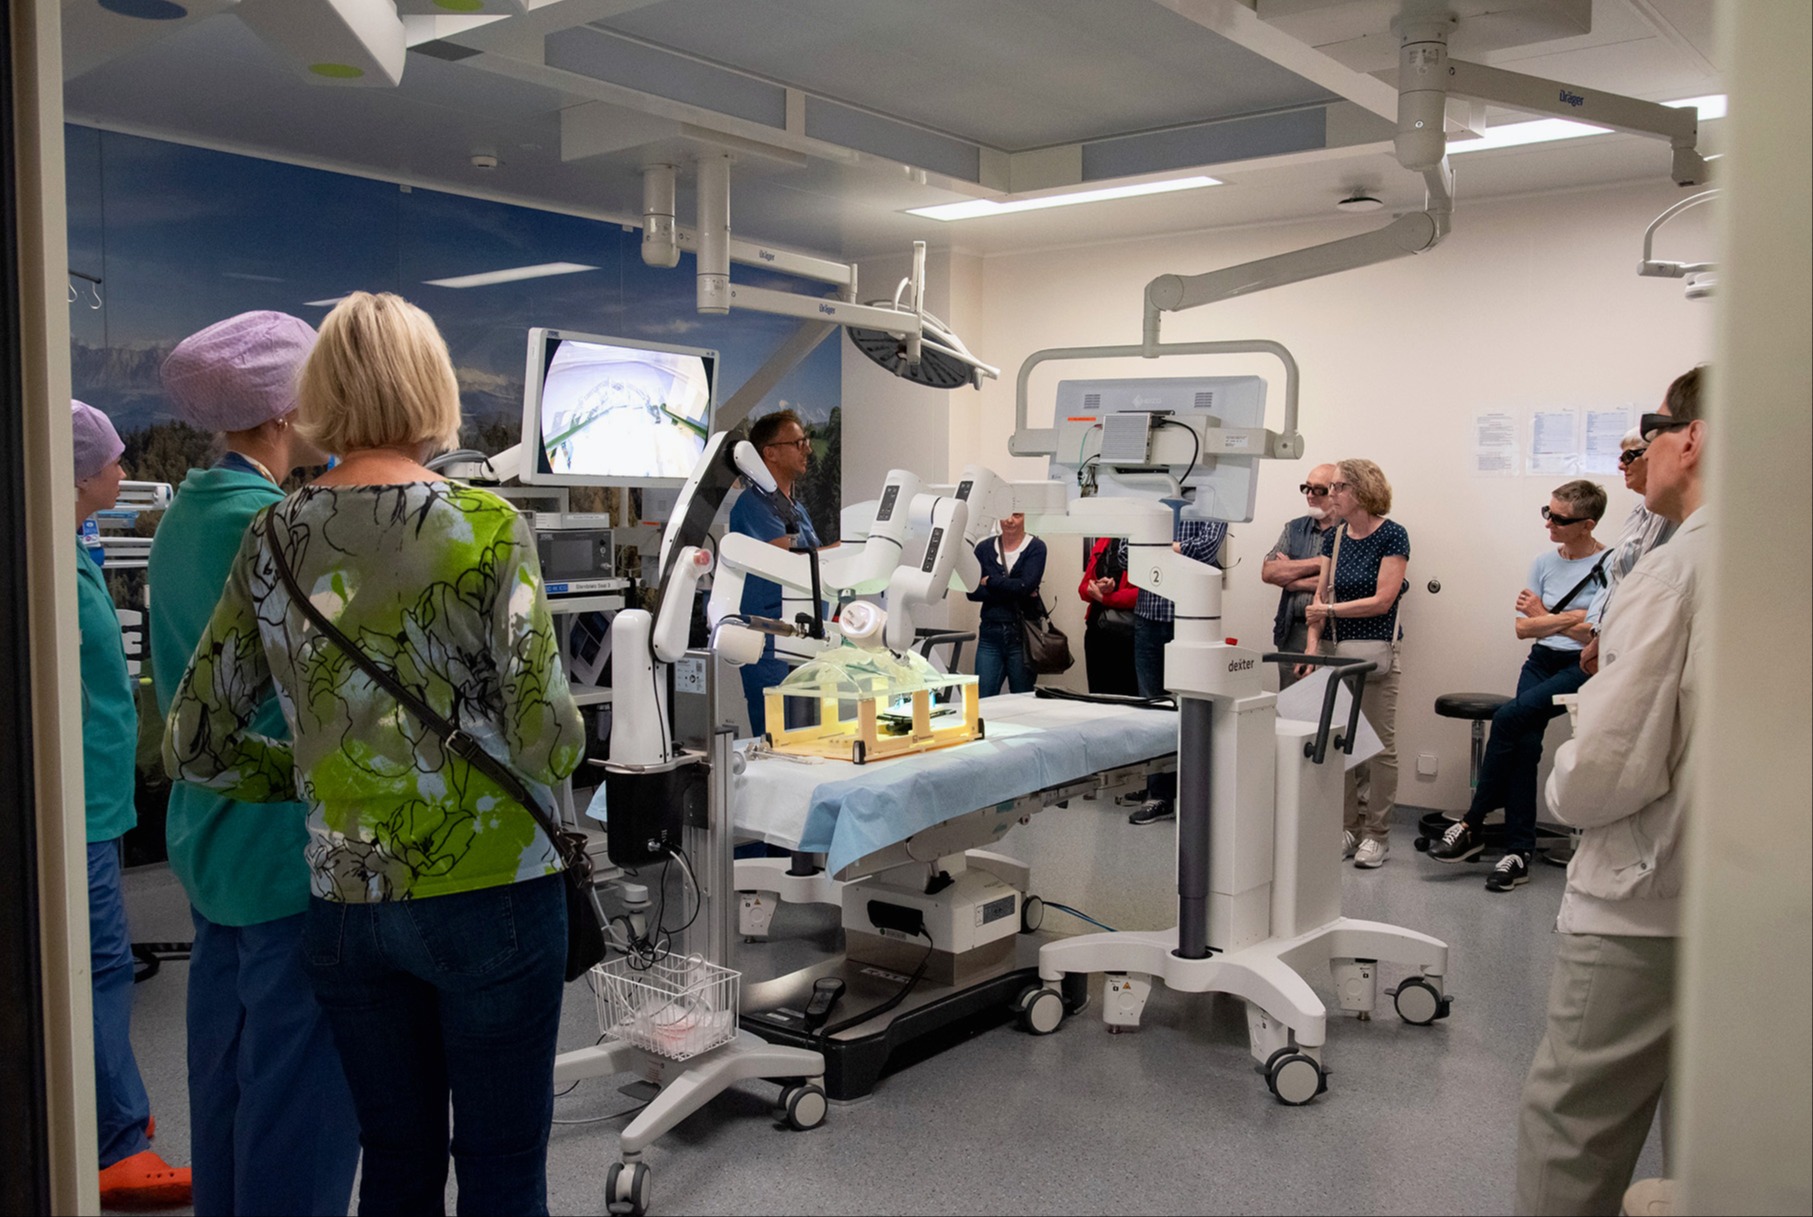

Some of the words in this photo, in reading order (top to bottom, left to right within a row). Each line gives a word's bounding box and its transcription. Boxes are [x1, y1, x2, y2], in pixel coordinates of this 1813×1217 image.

[1559, 89, 1584, 107] Dräger
[1153, 570, 1160, 583] 2
[1228, 658, 1255, 672] dexter
